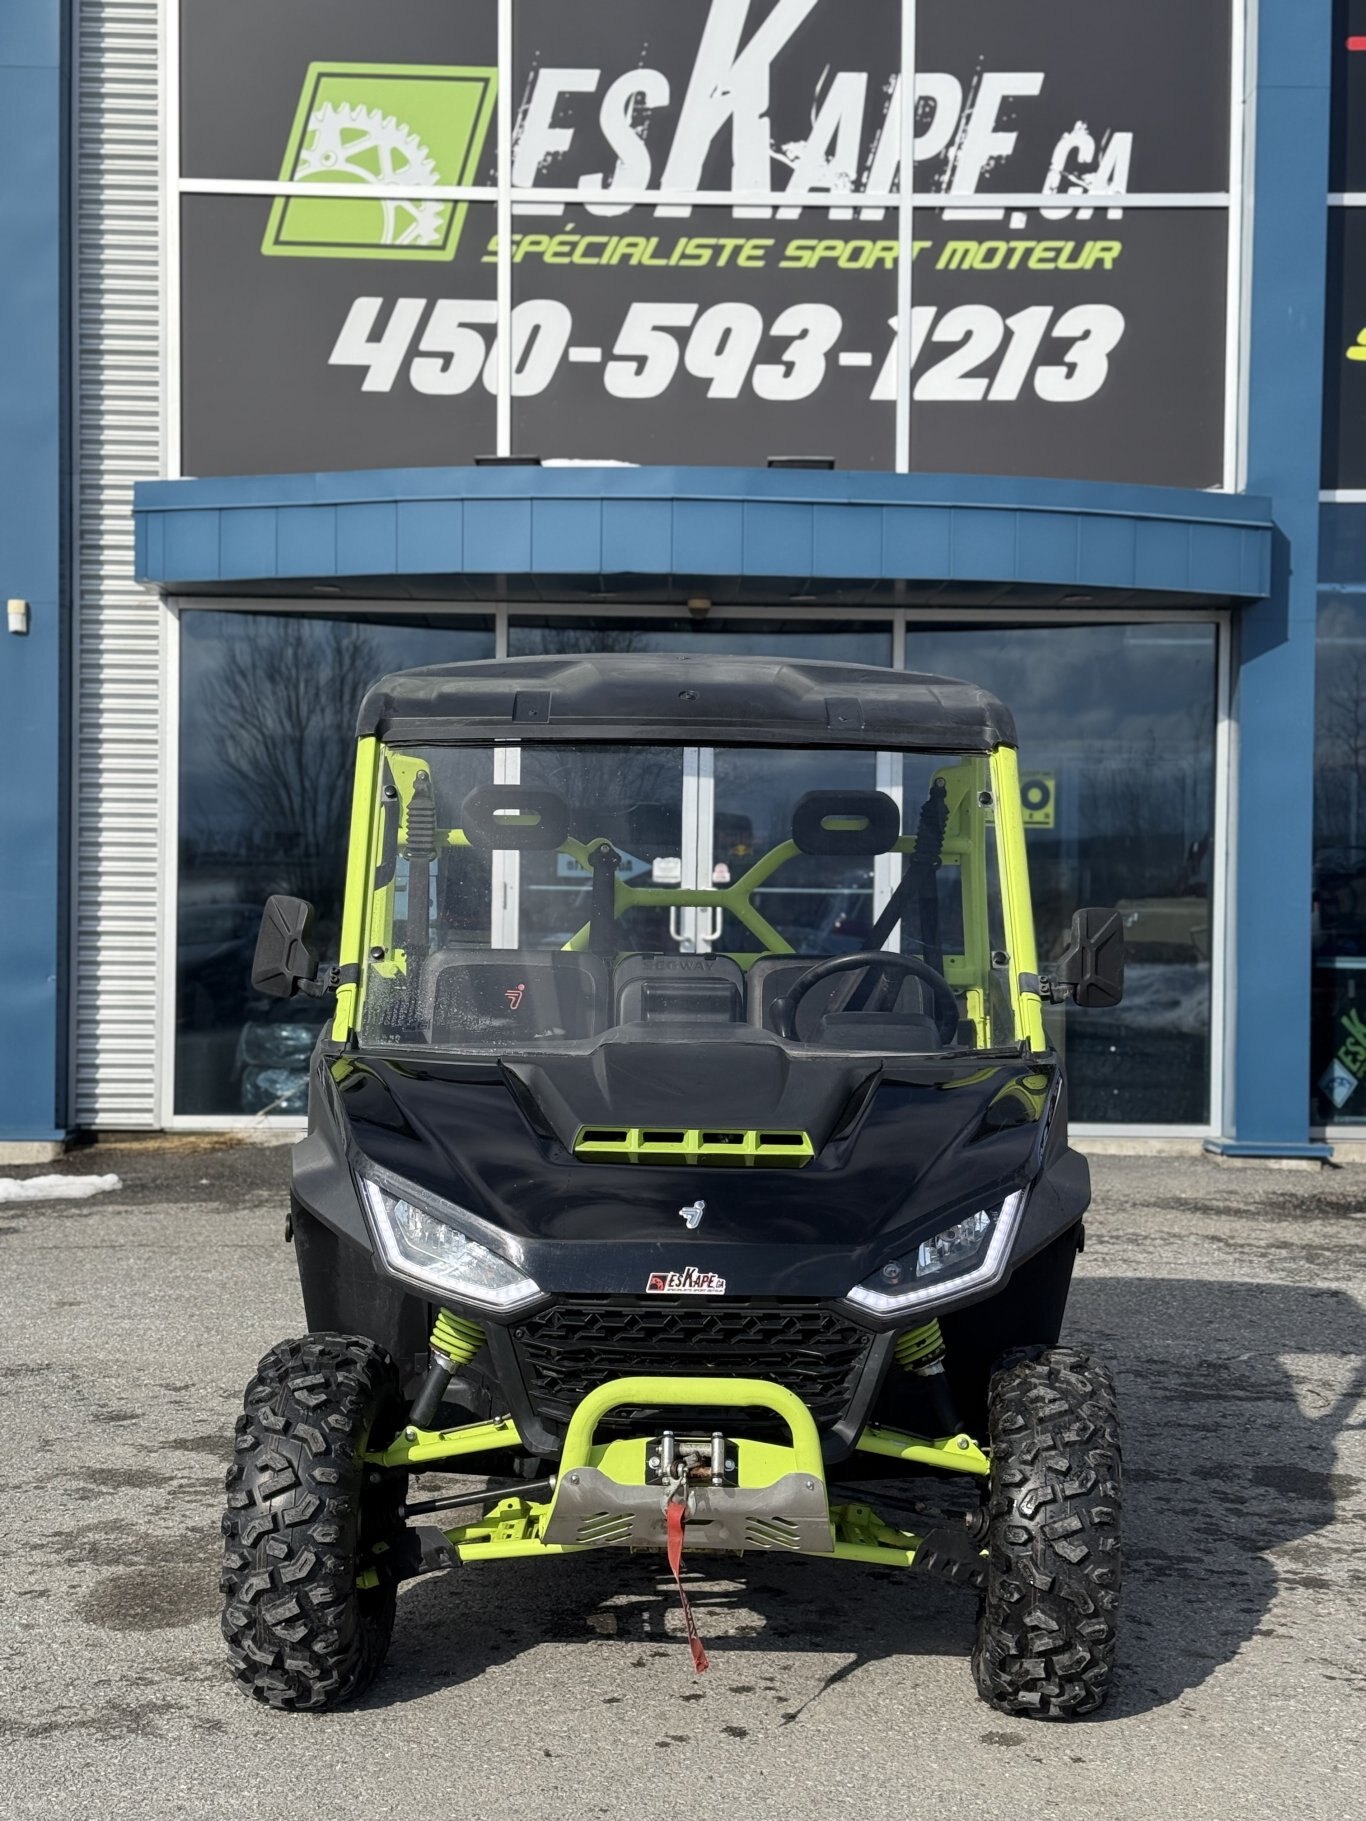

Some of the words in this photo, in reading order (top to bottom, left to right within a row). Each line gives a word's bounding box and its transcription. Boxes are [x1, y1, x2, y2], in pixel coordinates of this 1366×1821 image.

[481, 222, 774, 268] SPÉCIALISTE
[935, 240, 1122, 270] MOTEUR
[328, 297, 1126, 402] 450-593-1213
